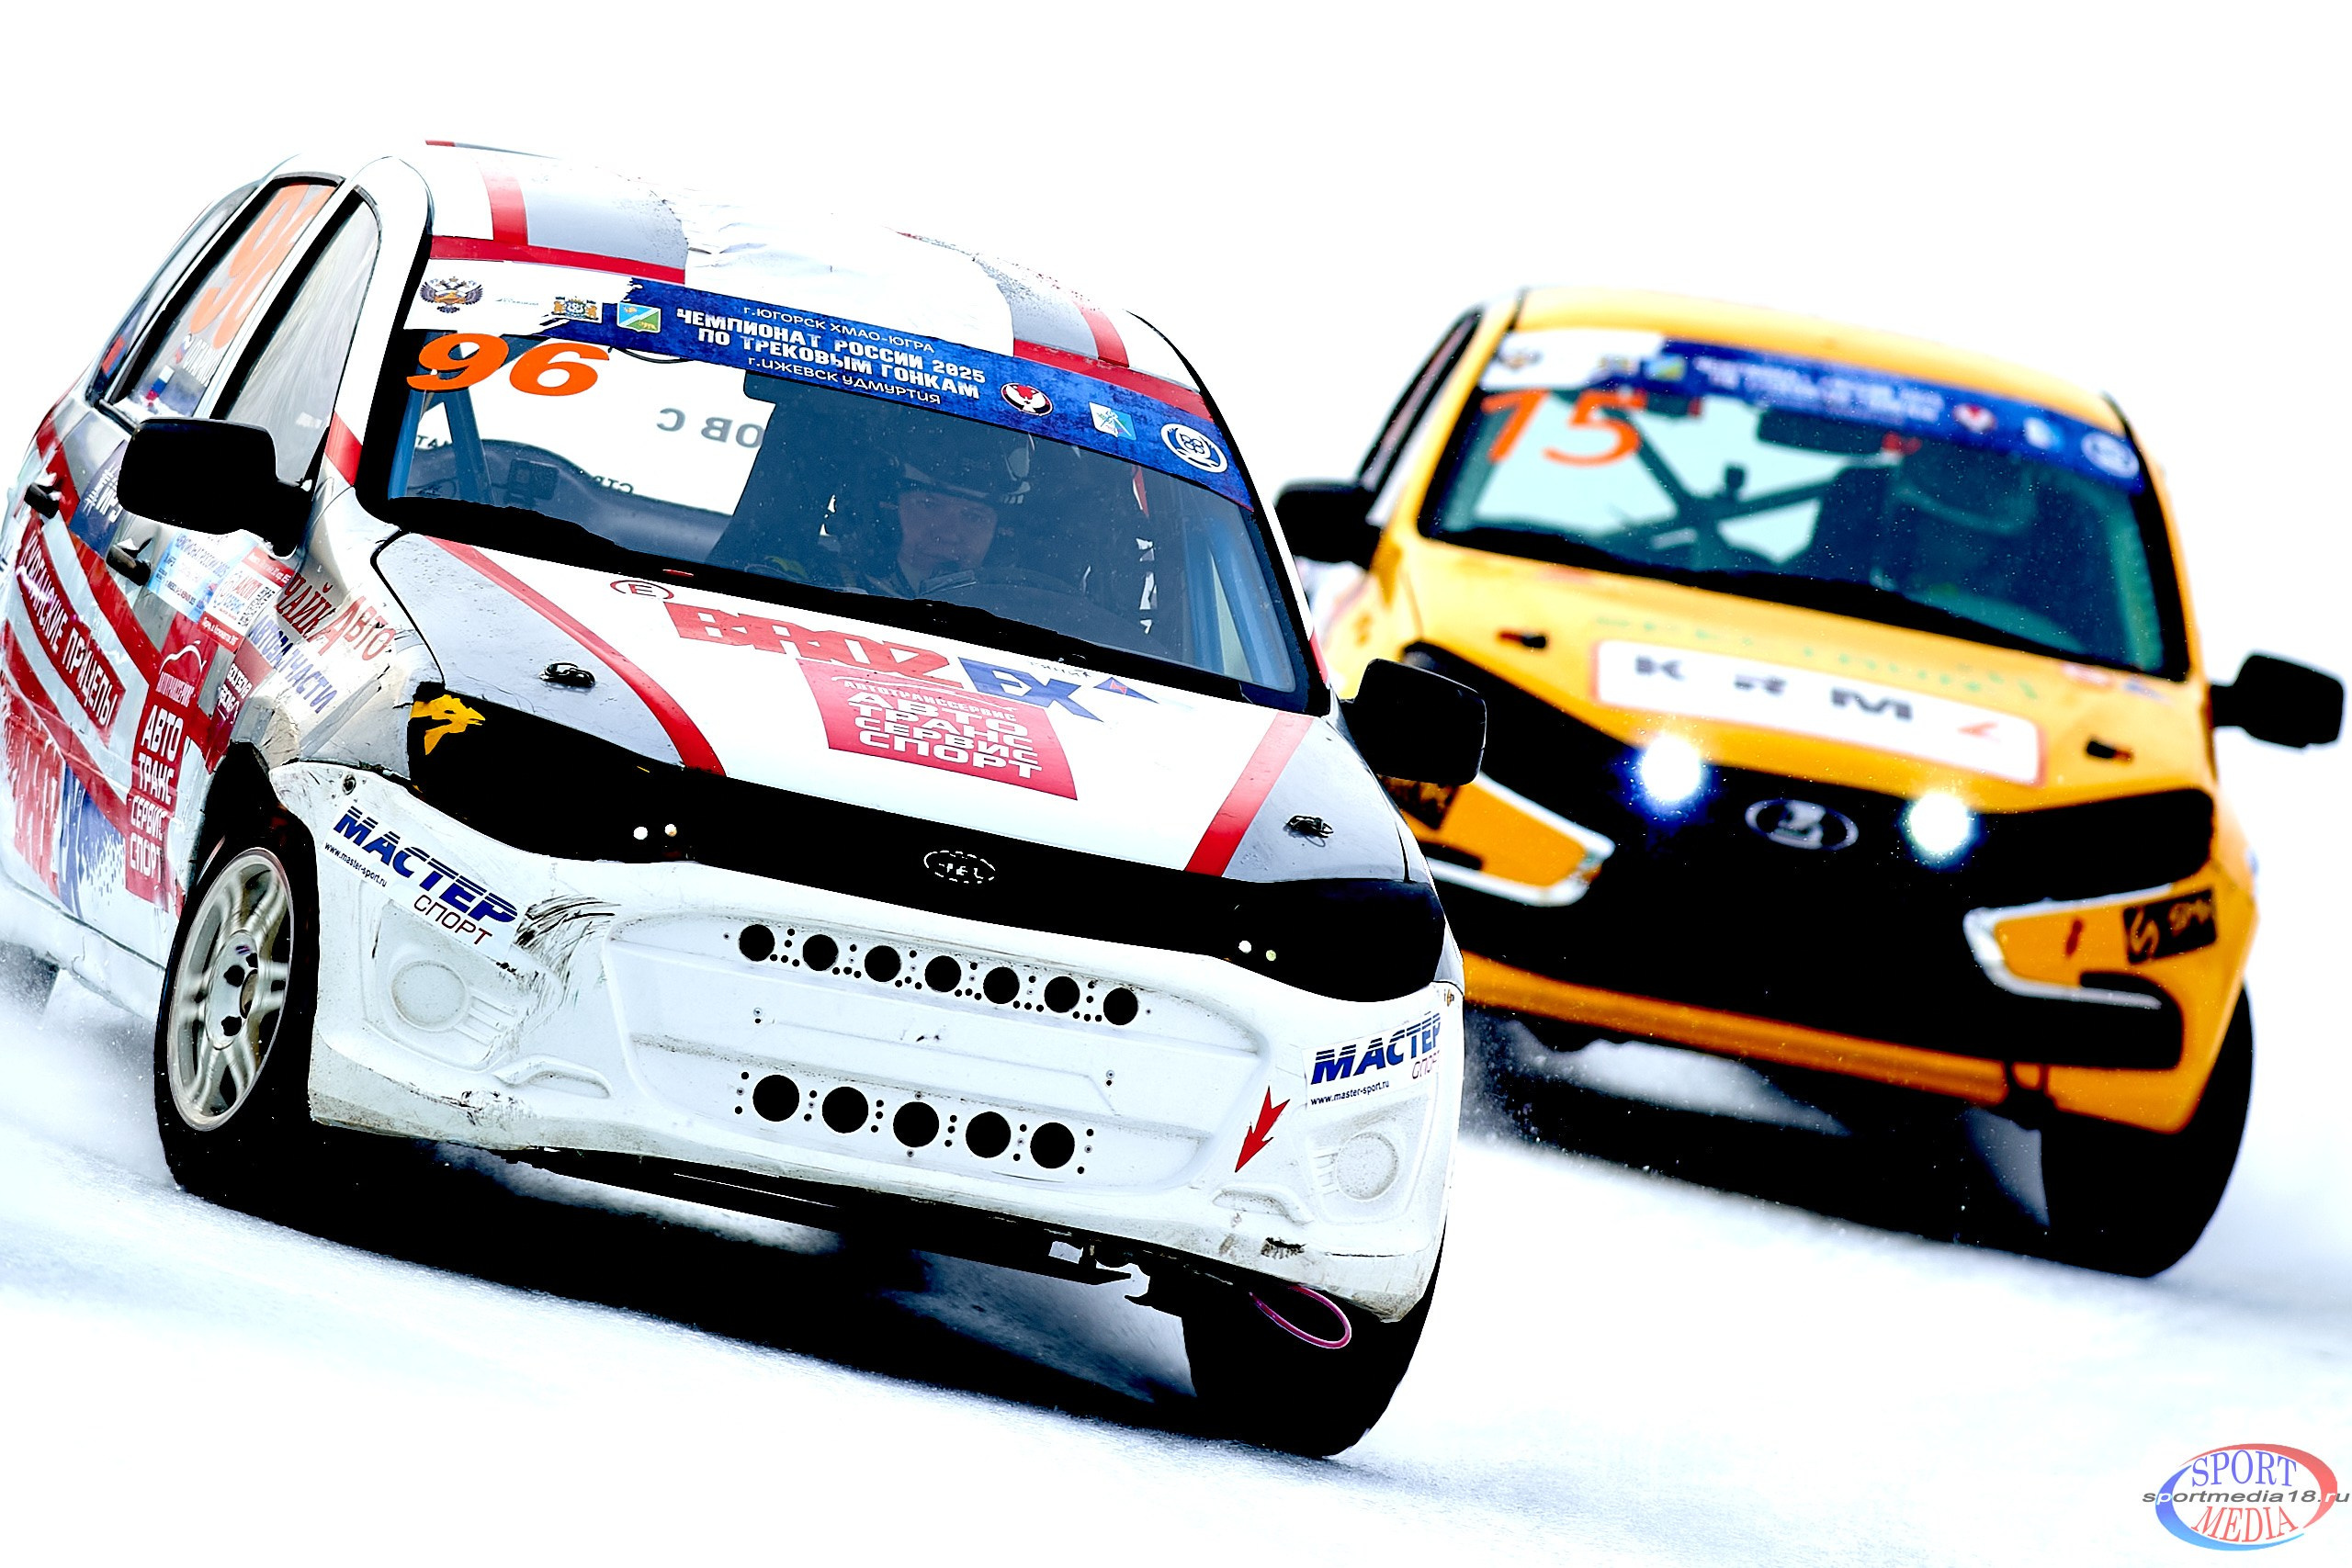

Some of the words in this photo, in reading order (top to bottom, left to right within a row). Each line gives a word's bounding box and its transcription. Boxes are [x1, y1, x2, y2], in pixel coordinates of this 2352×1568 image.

[676, 308, 821, 348] ЧЕМПИОНАТ
[834, 339, 924, 370] РОССИИ
[932, 359, 987, 384] 2025
[744, 306, 826, 330] г.ЮГОРСК
[830, 322, 935, 354] ХМАО-ЮГРА
[406, 332, 610, 397] 96
[697, 327, 731, 347] ПО
[740, 334, 874, 376] ТРЕКОВЫМ
[880, 363, 980, 400] ГОНКАМ
[747, 355, 839, 382] г.ИЖЕВСК
[842, 374, 942, 405] УДМУРТИЯ
[1480, 388, 1647, 468] 15
[62, 626, 119, 728] ПРИЦЕПЫ
[843, 681, 1017, 722] АВТОТРАНССЕРВИС
[141, 704, 185, 762] АВТО
[848, 691, 1028, 737] АВТО
[848, 701, 1033, 751] ТРАНС
[854, 716, 1038, 765] СЕРВИС
[859, 729, 1043, 779] СПОРТ
[138, 751, 175, 806] ТРАНС
[130, 795, 168, 841] СЕРВИС
[130, 831, 164, 885] СПОРТ
[324, 841, 388, 888] www.master-sport.ru
[333, 806, 518, 923] МАСТЕР
[413, 894, 493, 945] СПОРТ
[1310, 1011, 1441, 1086] МАСТЕР
[1310, 1079, 1390, 1106] www.master-sport.ru
